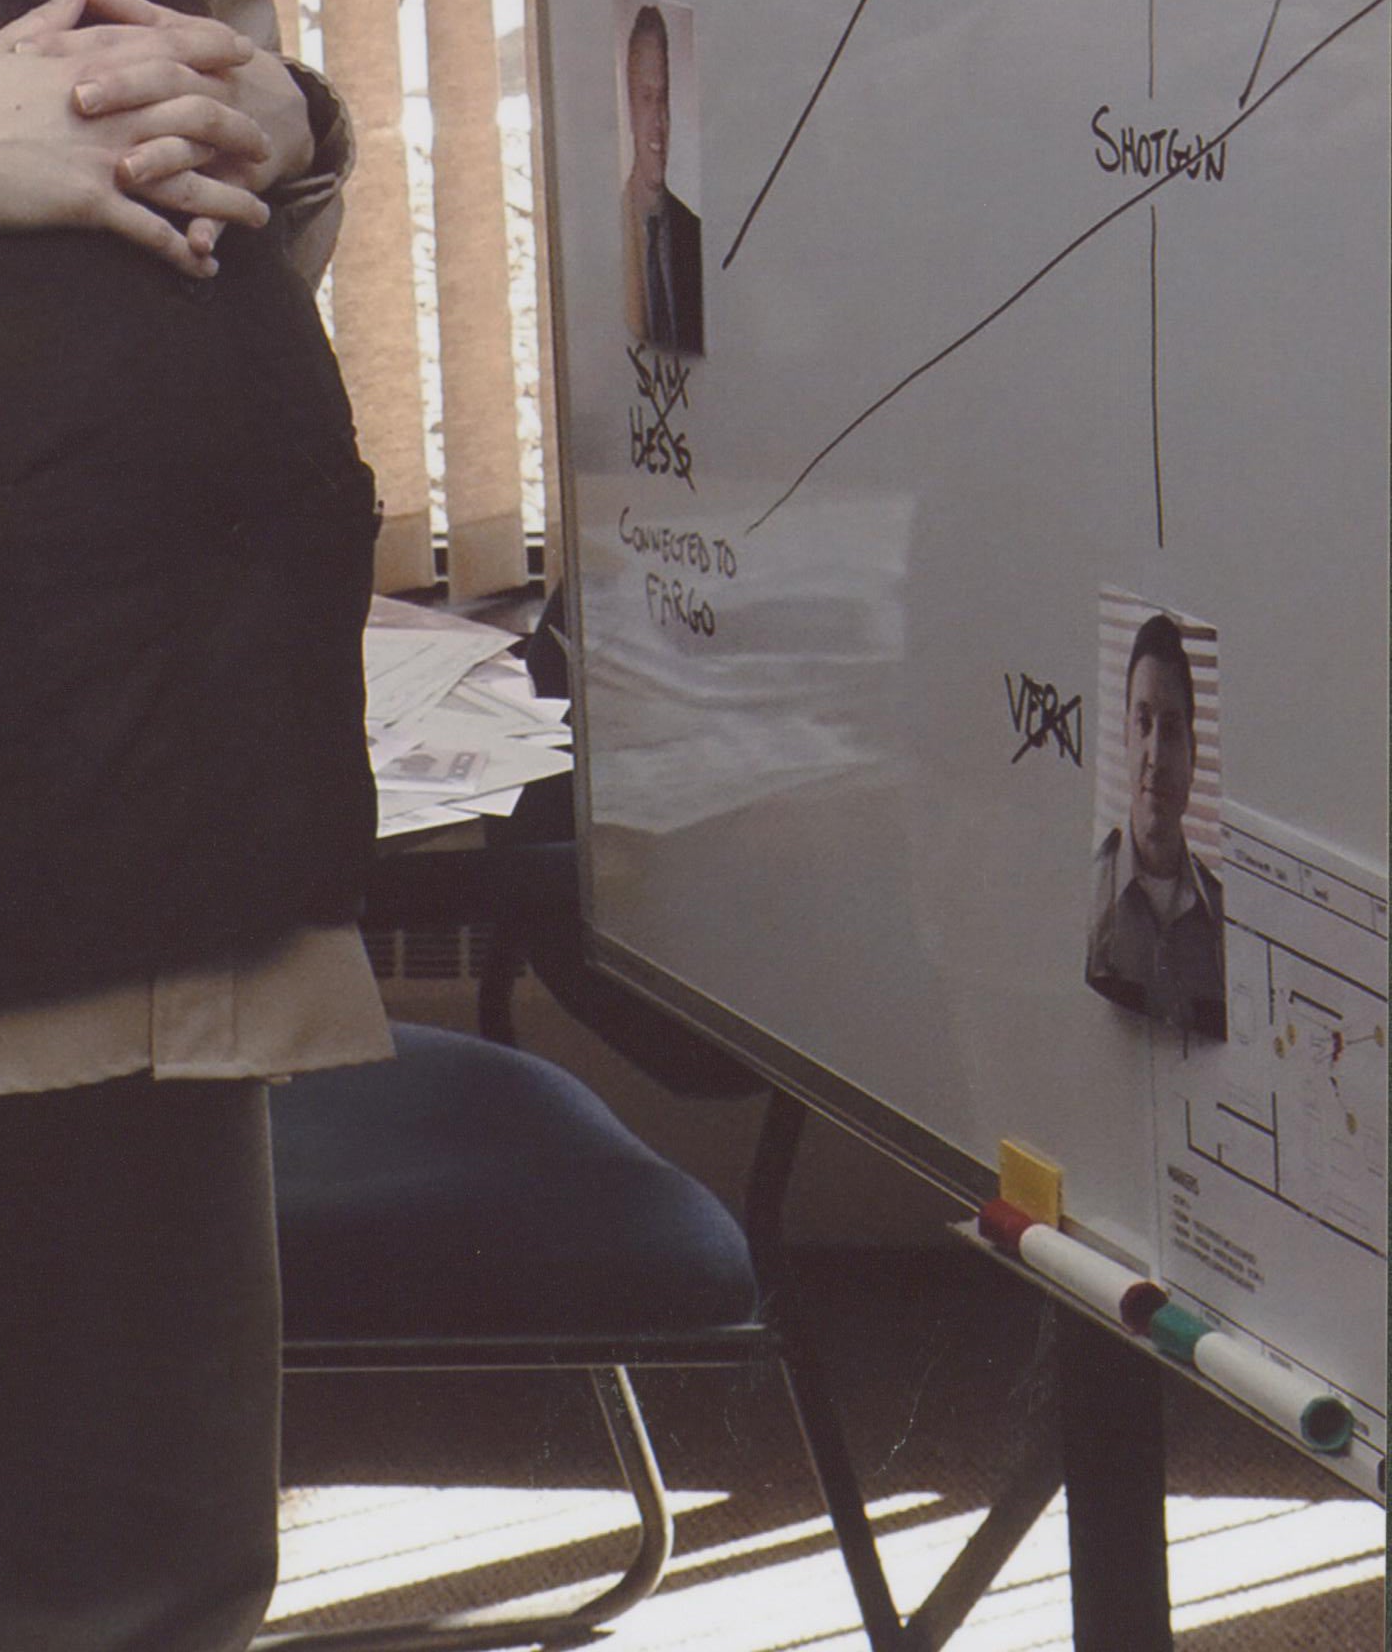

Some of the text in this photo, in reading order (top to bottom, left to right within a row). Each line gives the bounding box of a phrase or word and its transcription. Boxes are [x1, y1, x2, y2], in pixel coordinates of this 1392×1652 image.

[1091, 105, 1226, 181] SHOTGUN
[629, 406, 692, 478] HESS
[619, 507, 737, 579] CONNECTED TO
[646, 573, 715, 636] FARGO
